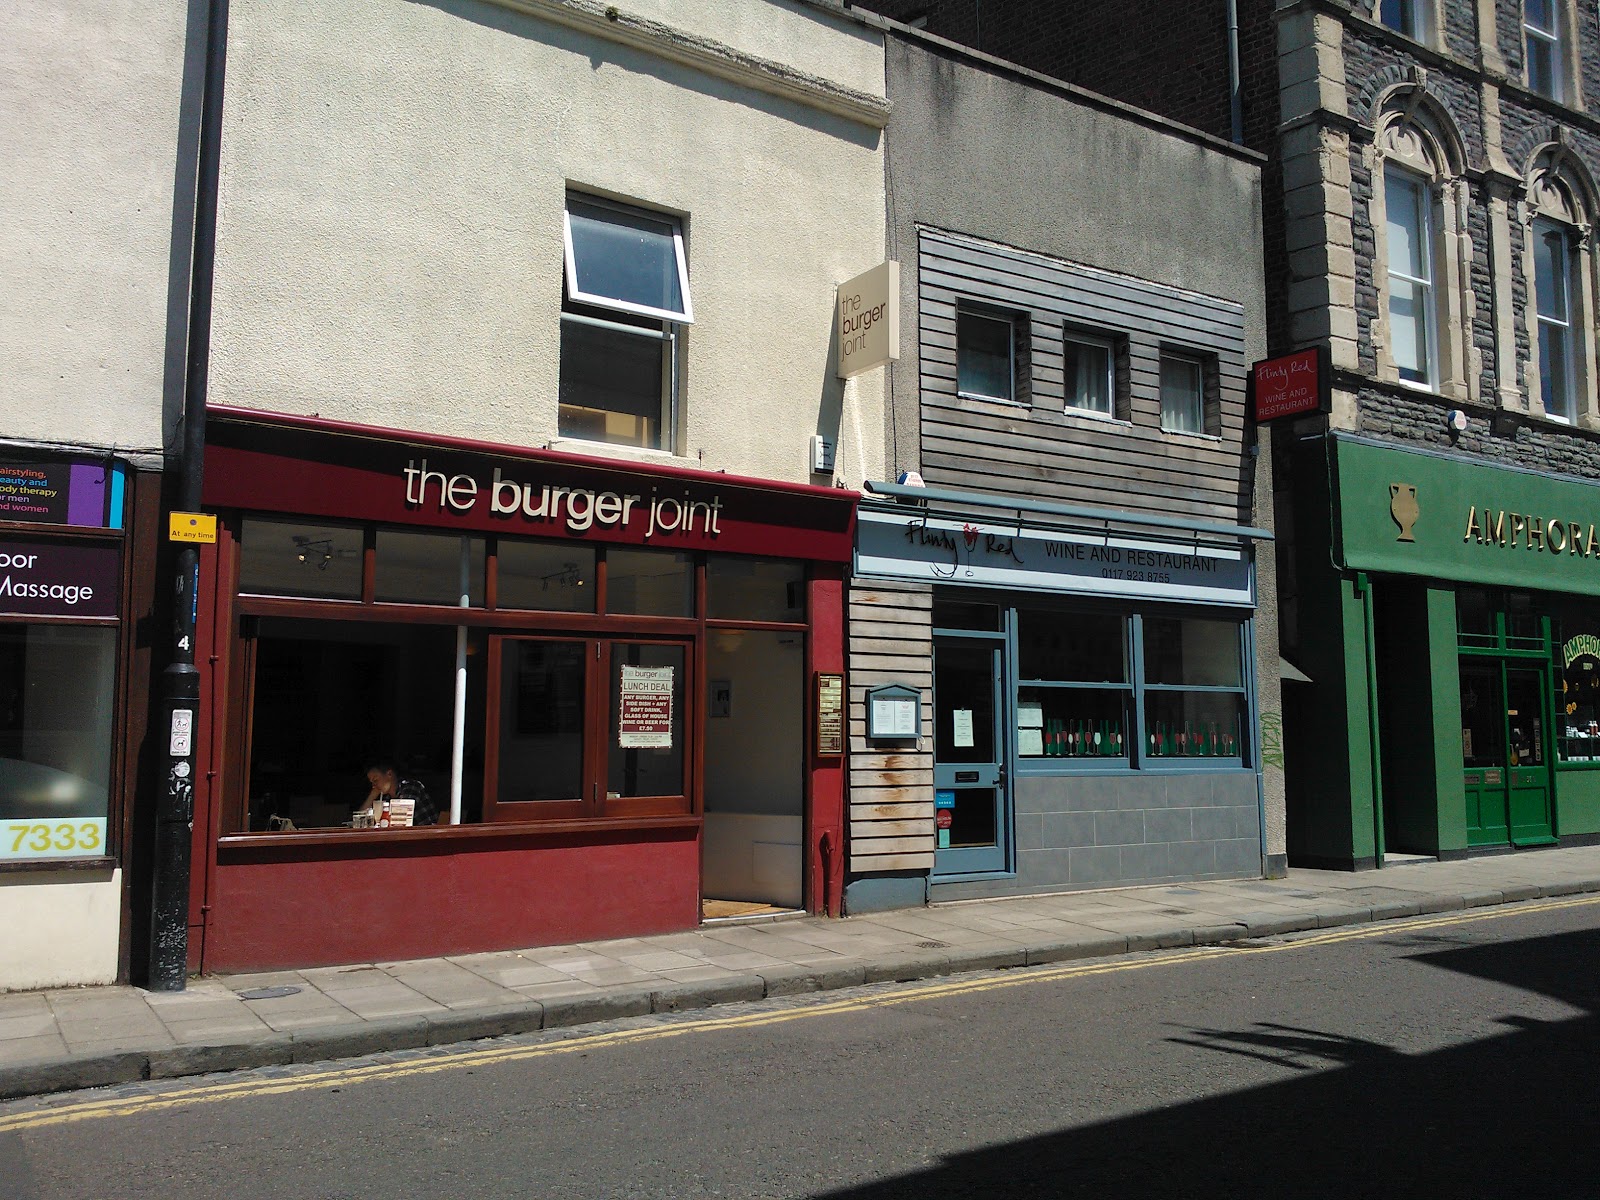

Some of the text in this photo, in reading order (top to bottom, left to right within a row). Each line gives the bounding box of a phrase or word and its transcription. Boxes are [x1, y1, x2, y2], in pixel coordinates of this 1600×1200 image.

[842, 294, 861, 315] the
[842, 303, 886, 335] burger
[841, 330, 866, 362] joint
[1291, 360, 1315, 373] Red
[1265, 387, 1307, 403] WINE AND
[1259, 397, 1314, 415] RESTAURANT
[29, 479, 48, 487] and
[7, 495, 30, 503] men
[19, 486, 58, 498] therapy
[403, 458, 724, 538] the burger joint
[12, 504, 49, 513] women
[183, 531, 197, 539] any
[198, 531, 215, 539] time
[1463, 505, 1600, 557] AMPHORA
[985, 533, 1024, 564] Red
[1045, 541, 1219, 573] WINE AND RESTAURANT
[1101, 567, 1171, 584] 0117 923 8755
[177, 635, 190, 651] 4
[635, 670, 658, 678] burger
[623, 682, 671, 692] LUNCH DEAL
[8, 823, 101, 852] 7333
